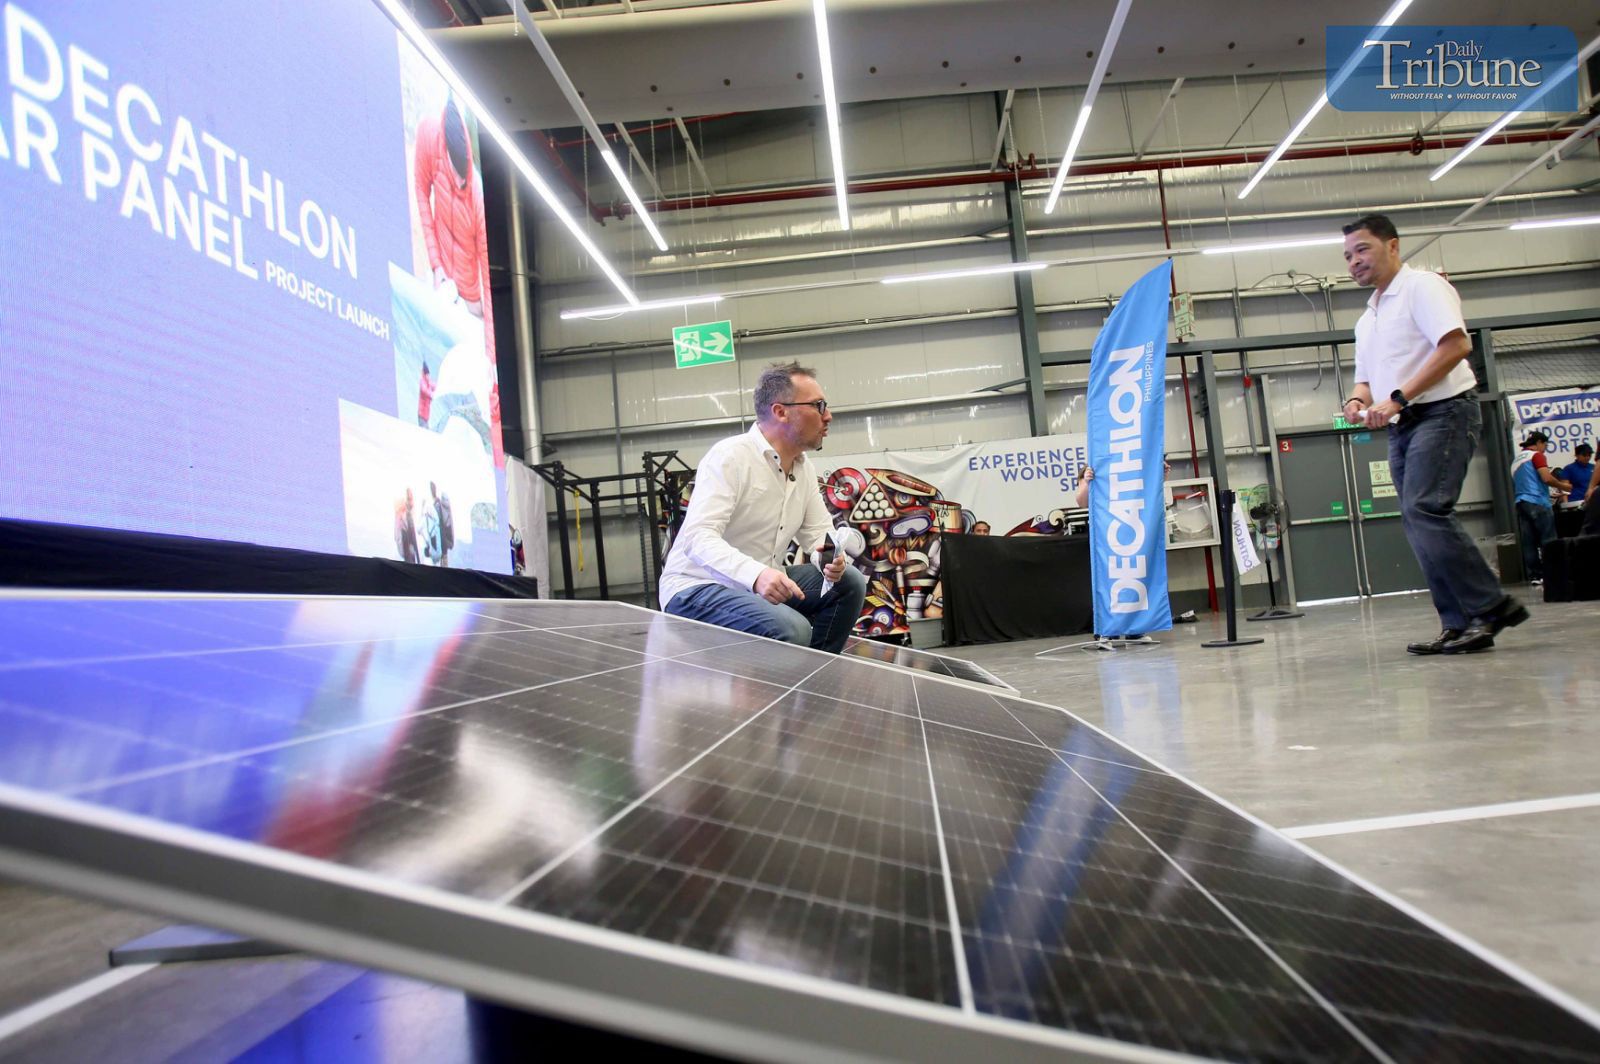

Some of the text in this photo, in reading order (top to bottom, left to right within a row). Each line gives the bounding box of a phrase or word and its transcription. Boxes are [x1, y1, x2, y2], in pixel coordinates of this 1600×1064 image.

[4, 2, 358, 280] DECATHLON
[81, 130, 258, 280] PANEL
[265, 260, 334, 313] PROJECT
[337, 297, 389, 341] LAUNCH
[1144, 340, 1154, 402] PHILIPPINES
[968, 446, 1086, 471] EXPERIENCE
[1106, 344, 1149, 614] DECATHLON
[1282, 441, 1289, 451] 3
